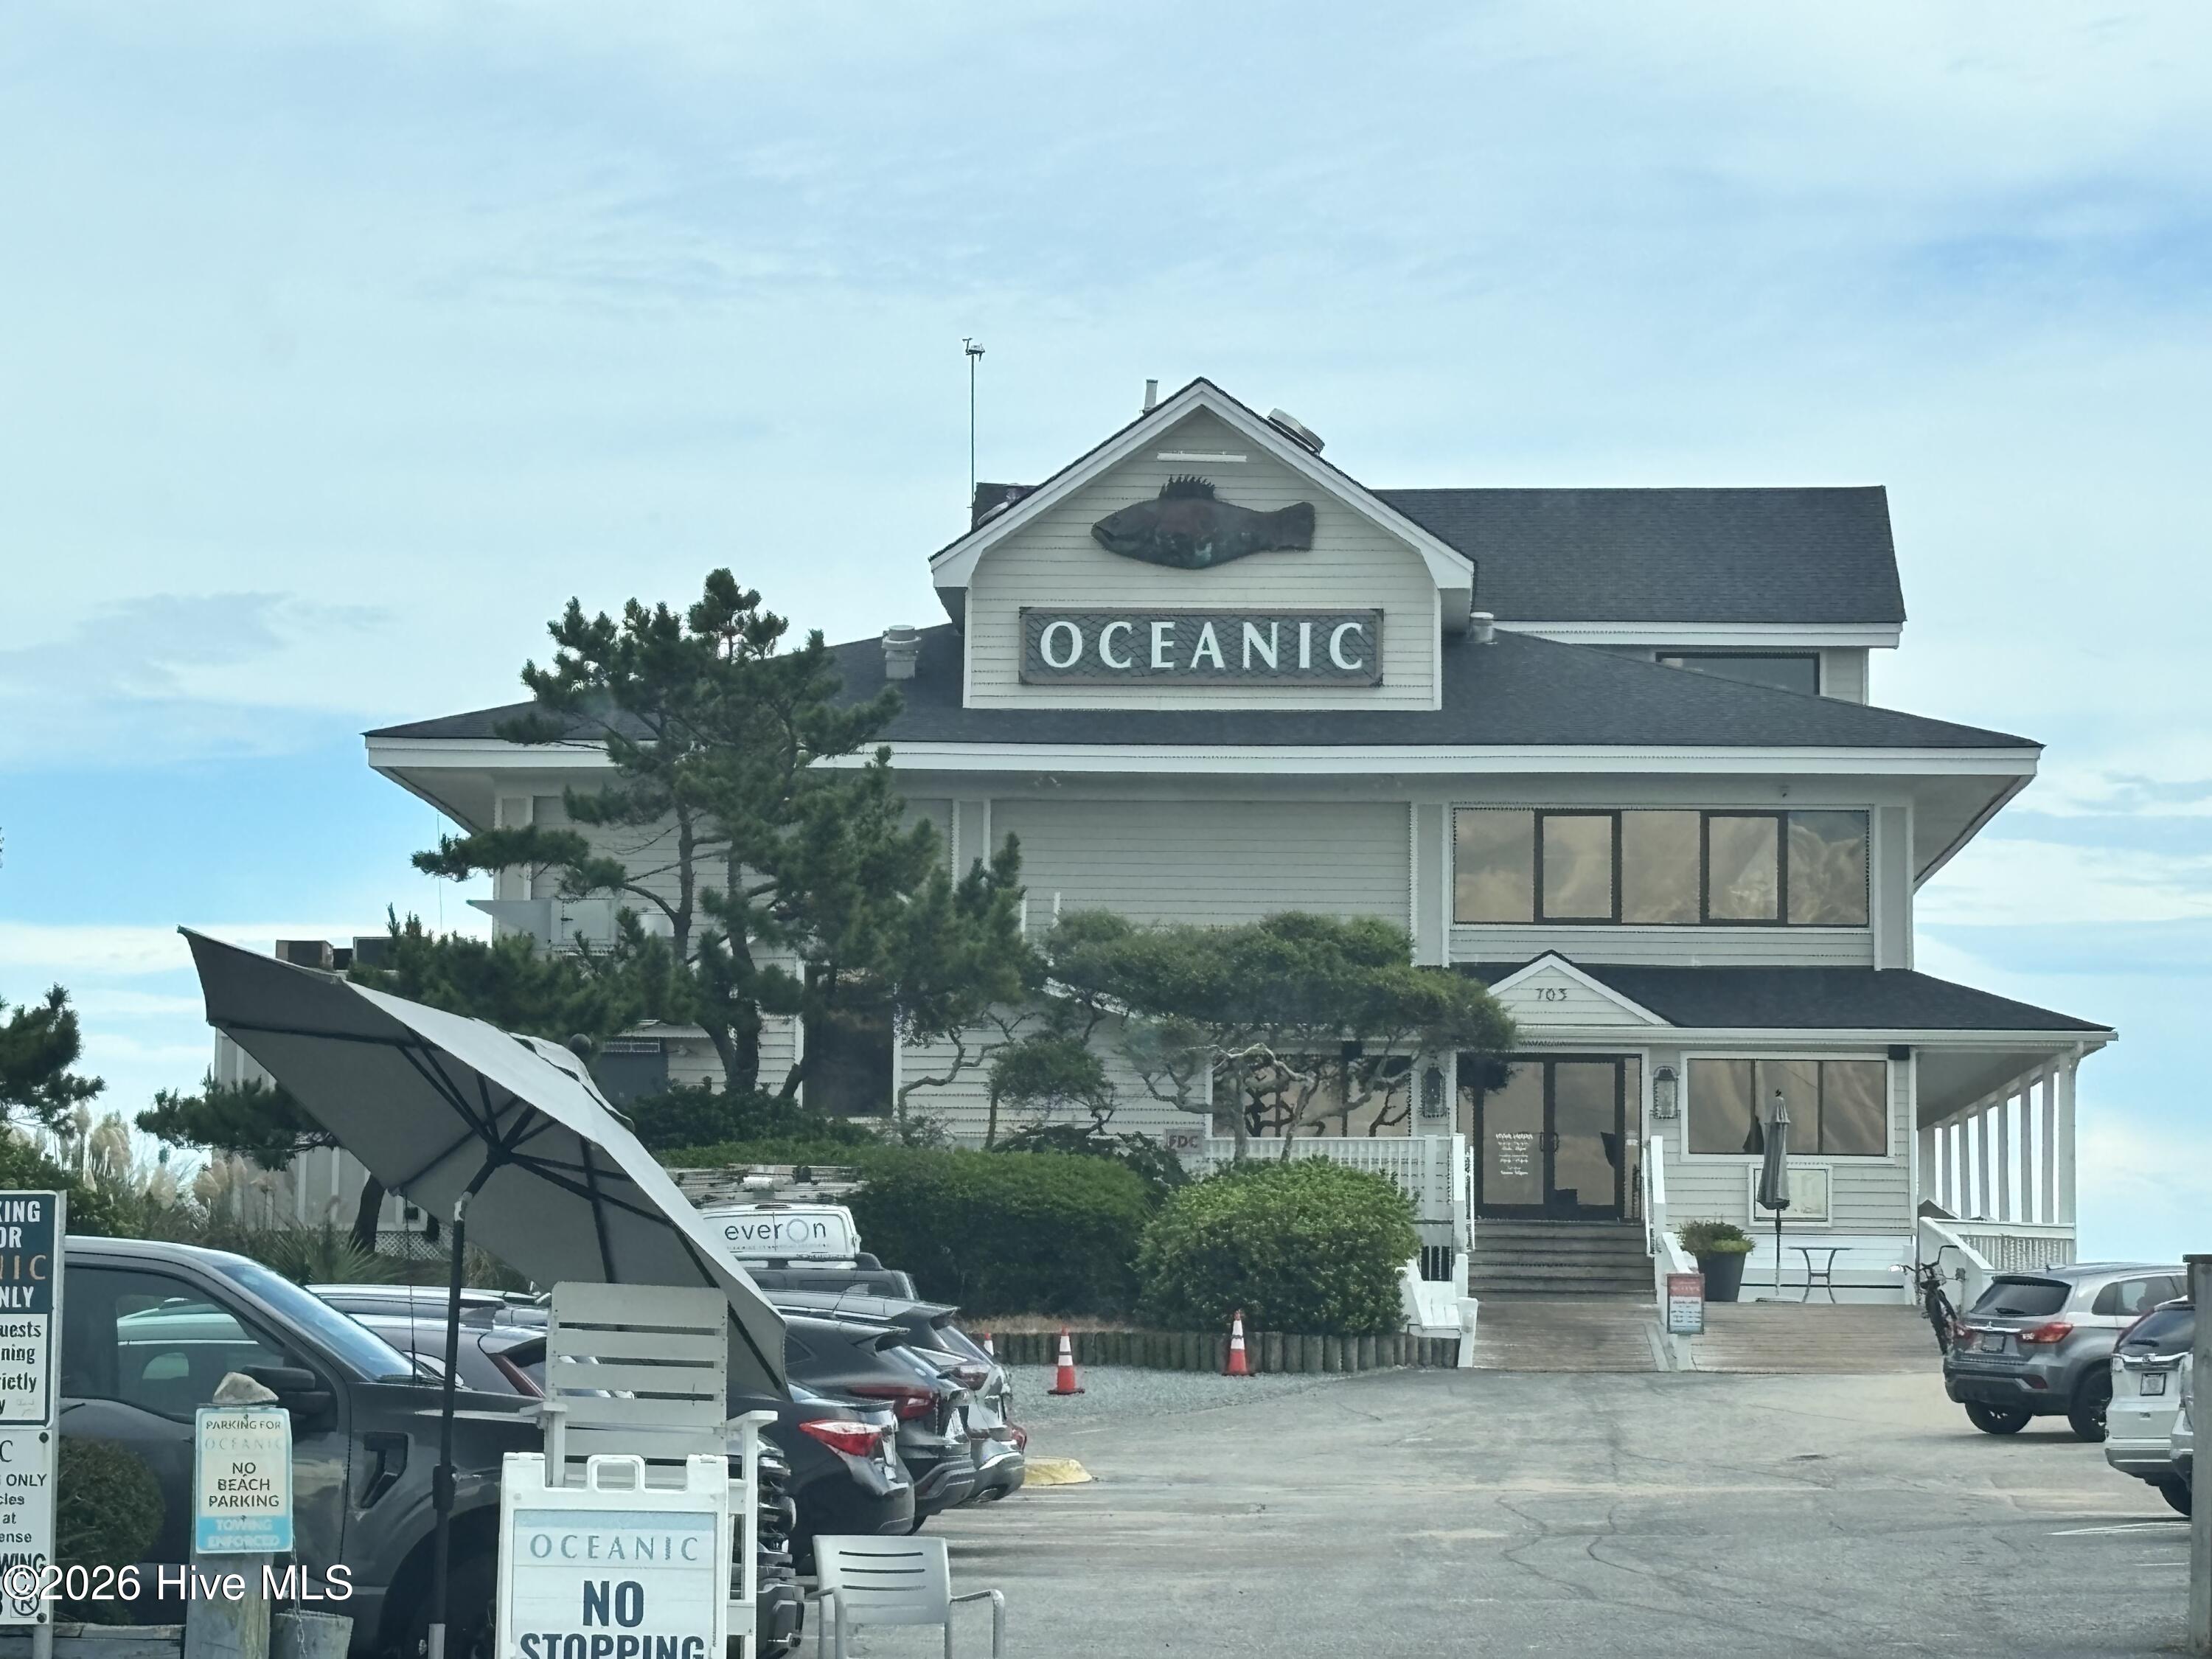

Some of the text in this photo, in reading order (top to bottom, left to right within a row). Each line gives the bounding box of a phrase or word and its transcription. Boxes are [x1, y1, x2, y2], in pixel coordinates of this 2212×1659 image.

[1040, 621, 1363, 670] OCEANIC
[1535, 987, 1568, 1001] 703
[0, 1200, 41, 1222] ING
[0, 1372, 37, 1393] ictly
[206, 1420, 281, 1430] PARKING FOR
[205, 1438, 283, 1450] OCEANIC
[232, 1462, 256, 1475] NO
[6, 1473, 47, 1486] ONLY
[218, 1478, 270, 1491] BEACH
[209, 1495, 279, 1507] PARKING
[2, 1512, 16, 1524] at
[215, 1519, 273, 1531] TOWING
[529, 1534, 698, 1561] OCEANIC
[582, 1580, 644, 1628] NO
[520, 1632, 704, 1659] STOPPING
